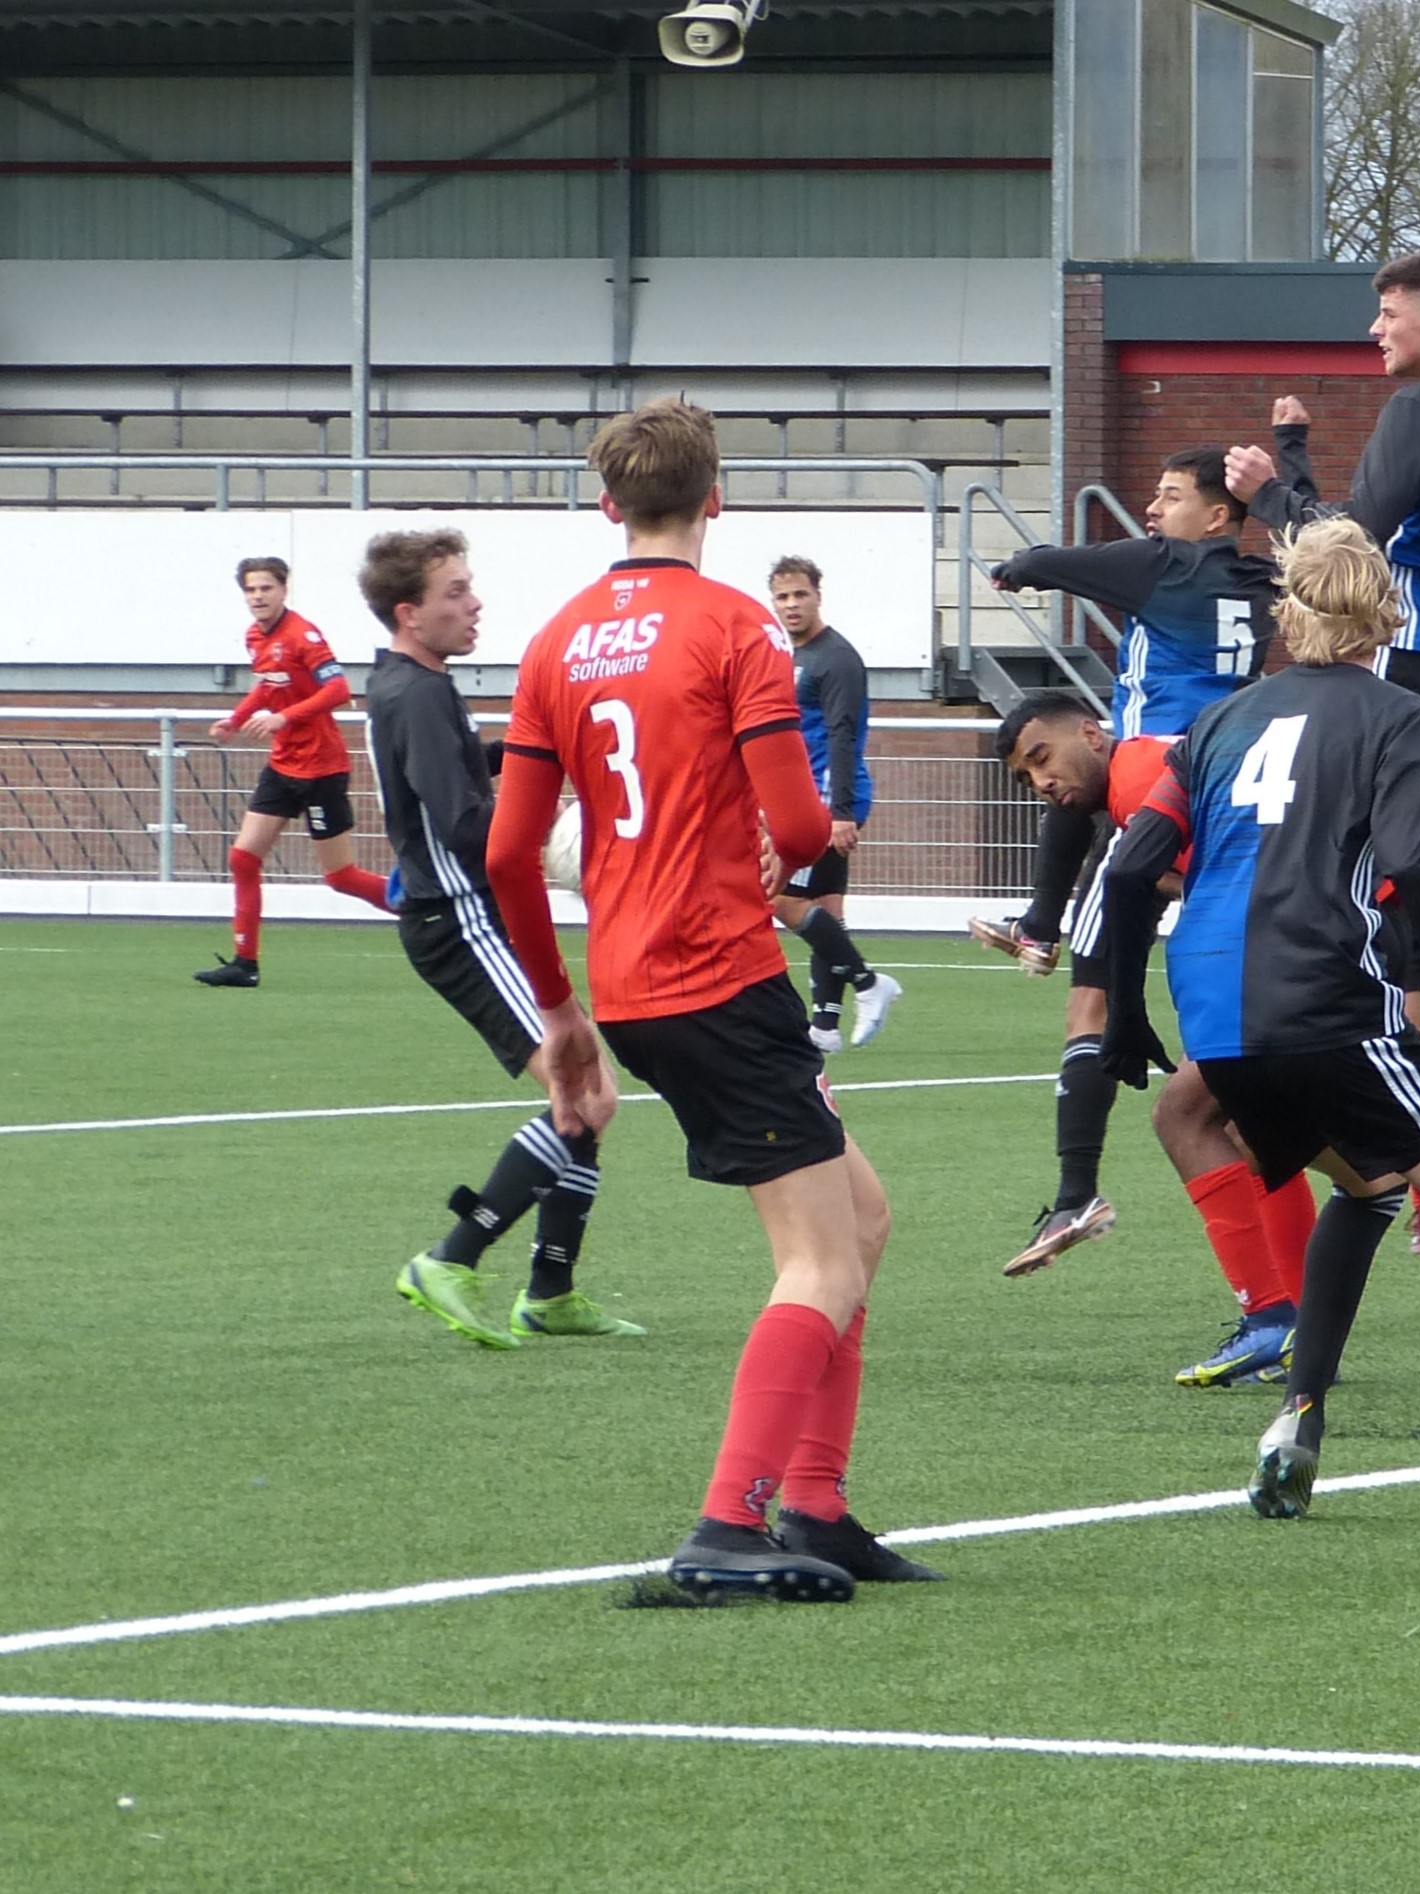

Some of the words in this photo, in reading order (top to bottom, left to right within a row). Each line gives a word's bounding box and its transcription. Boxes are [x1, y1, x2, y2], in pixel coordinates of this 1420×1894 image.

[563, 613, 664, 663] AFAS
[568, 653, 649, 682] software
[1216, 598, 1256, 676] 5
[590, 699, 644, 839] 3
[1231, 714, 1308, 824] 4
